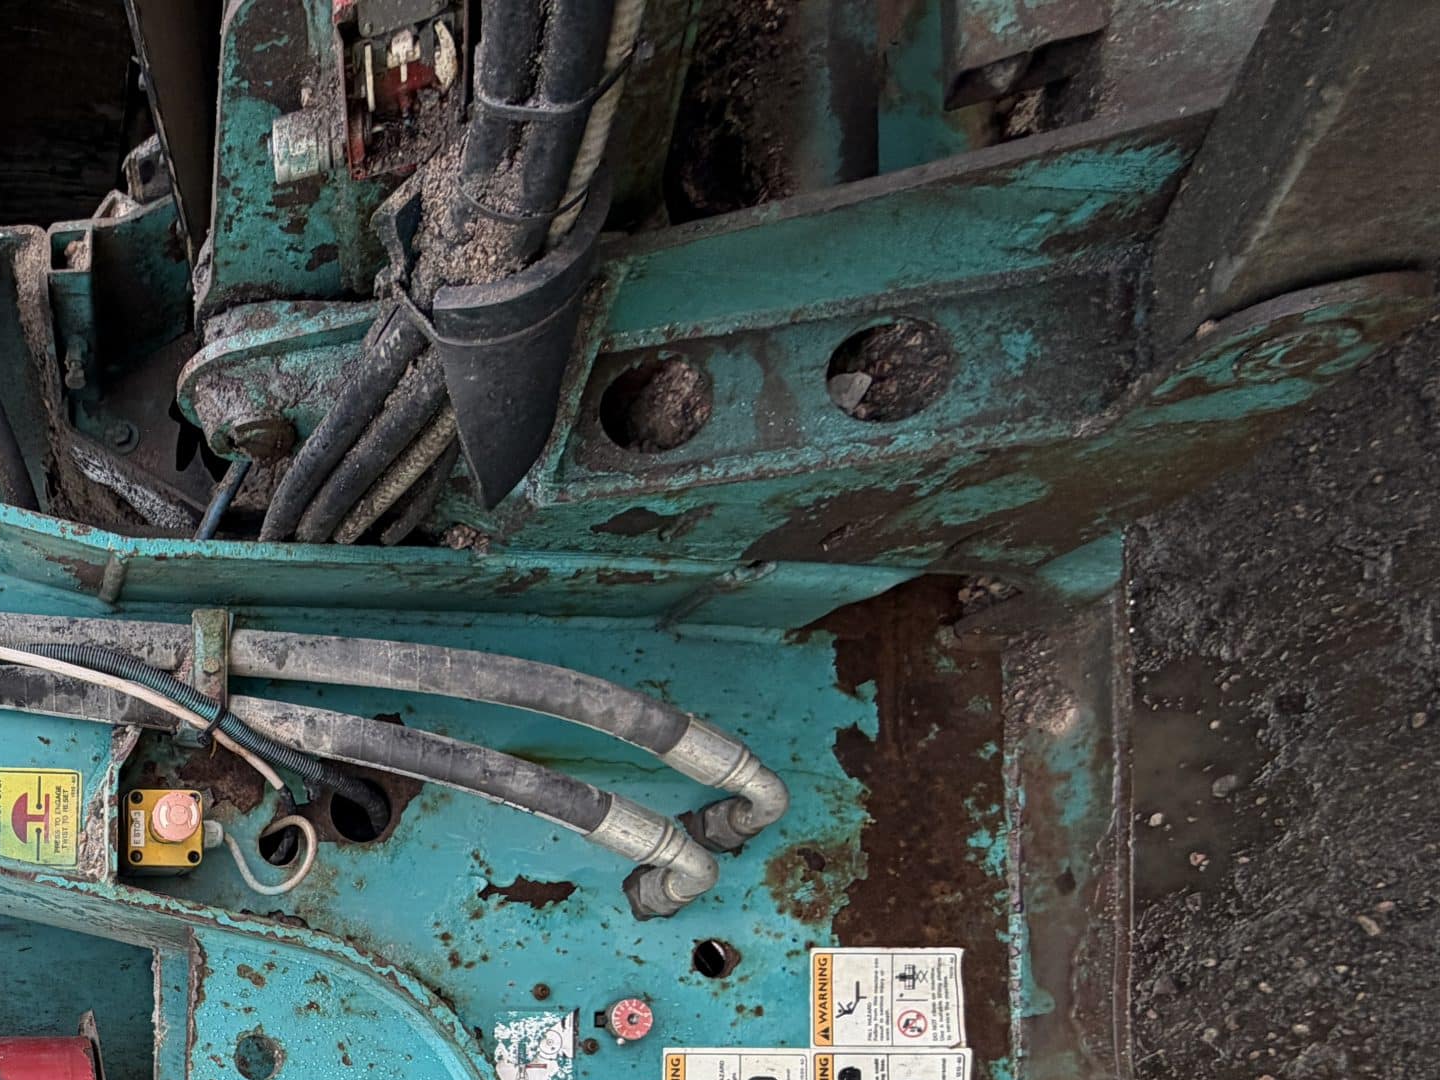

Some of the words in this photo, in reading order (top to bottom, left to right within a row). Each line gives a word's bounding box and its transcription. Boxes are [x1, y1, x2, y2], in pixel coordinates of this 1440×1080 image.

[54, 816, 61, 826] TO
[62, 814, 68, 824] TO
[818, 957, 828, 1024] WARNING
